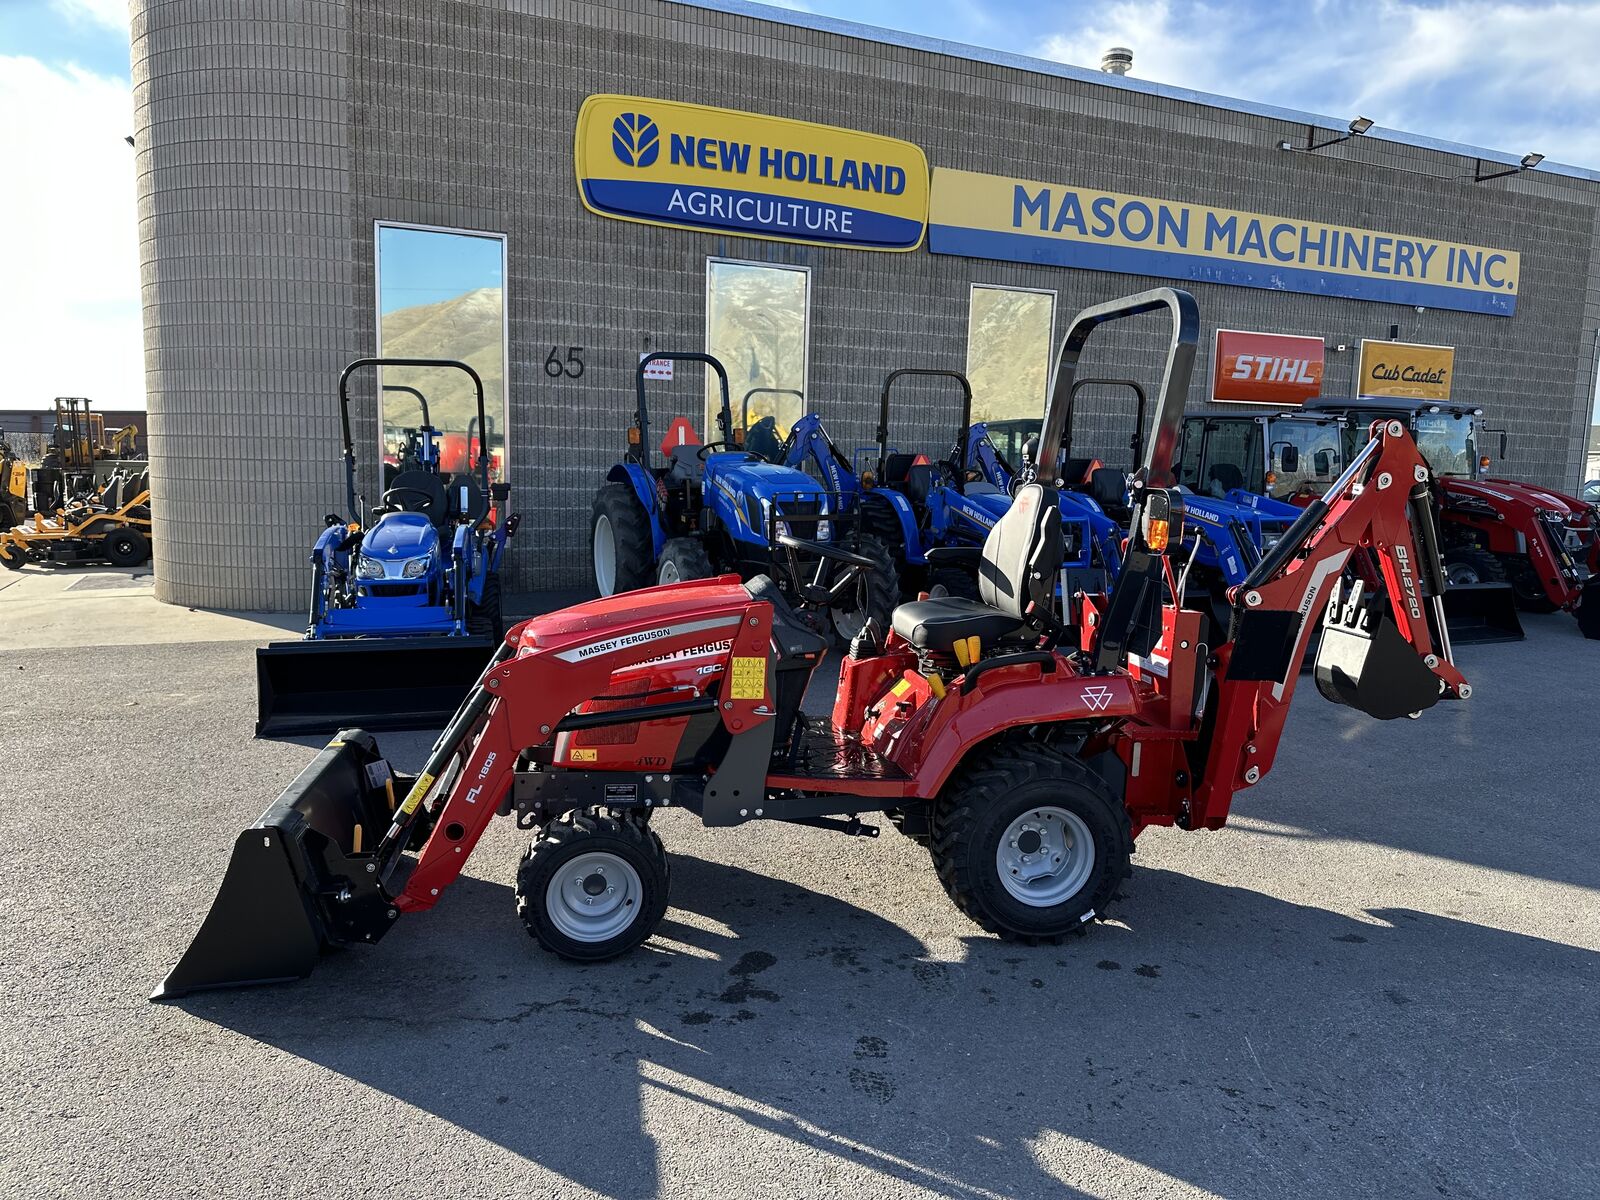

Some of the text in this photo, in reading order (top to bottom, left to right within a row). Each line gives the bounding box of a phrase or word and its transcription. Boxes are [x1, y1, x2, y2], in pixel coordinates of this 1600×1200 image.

[670, 133, 906, 196] NEW HOLLAND
[667, 188, 853, 234] AGRICULTURE
[1012, 185, 1514, 290] MASON MACHINERY INC.
[544, 346, 584, 379] 65
[1231, 353, 1316, 385] STIHL
[1372, 363, 1447, 384] Cub Cadet
[962, 505, 975, 517] NEW
[1190, 506, 1219, 522] HOLLAND
[1395, 545, 1421, 619] BH.2720
[1299, 586, 1317, 622] GUSON
[578, 628, 671, 658] MASSEY FERGUSON
[683, 641, 731, 657] FERGUS
[465, 751, 497, 804] FL 1805
